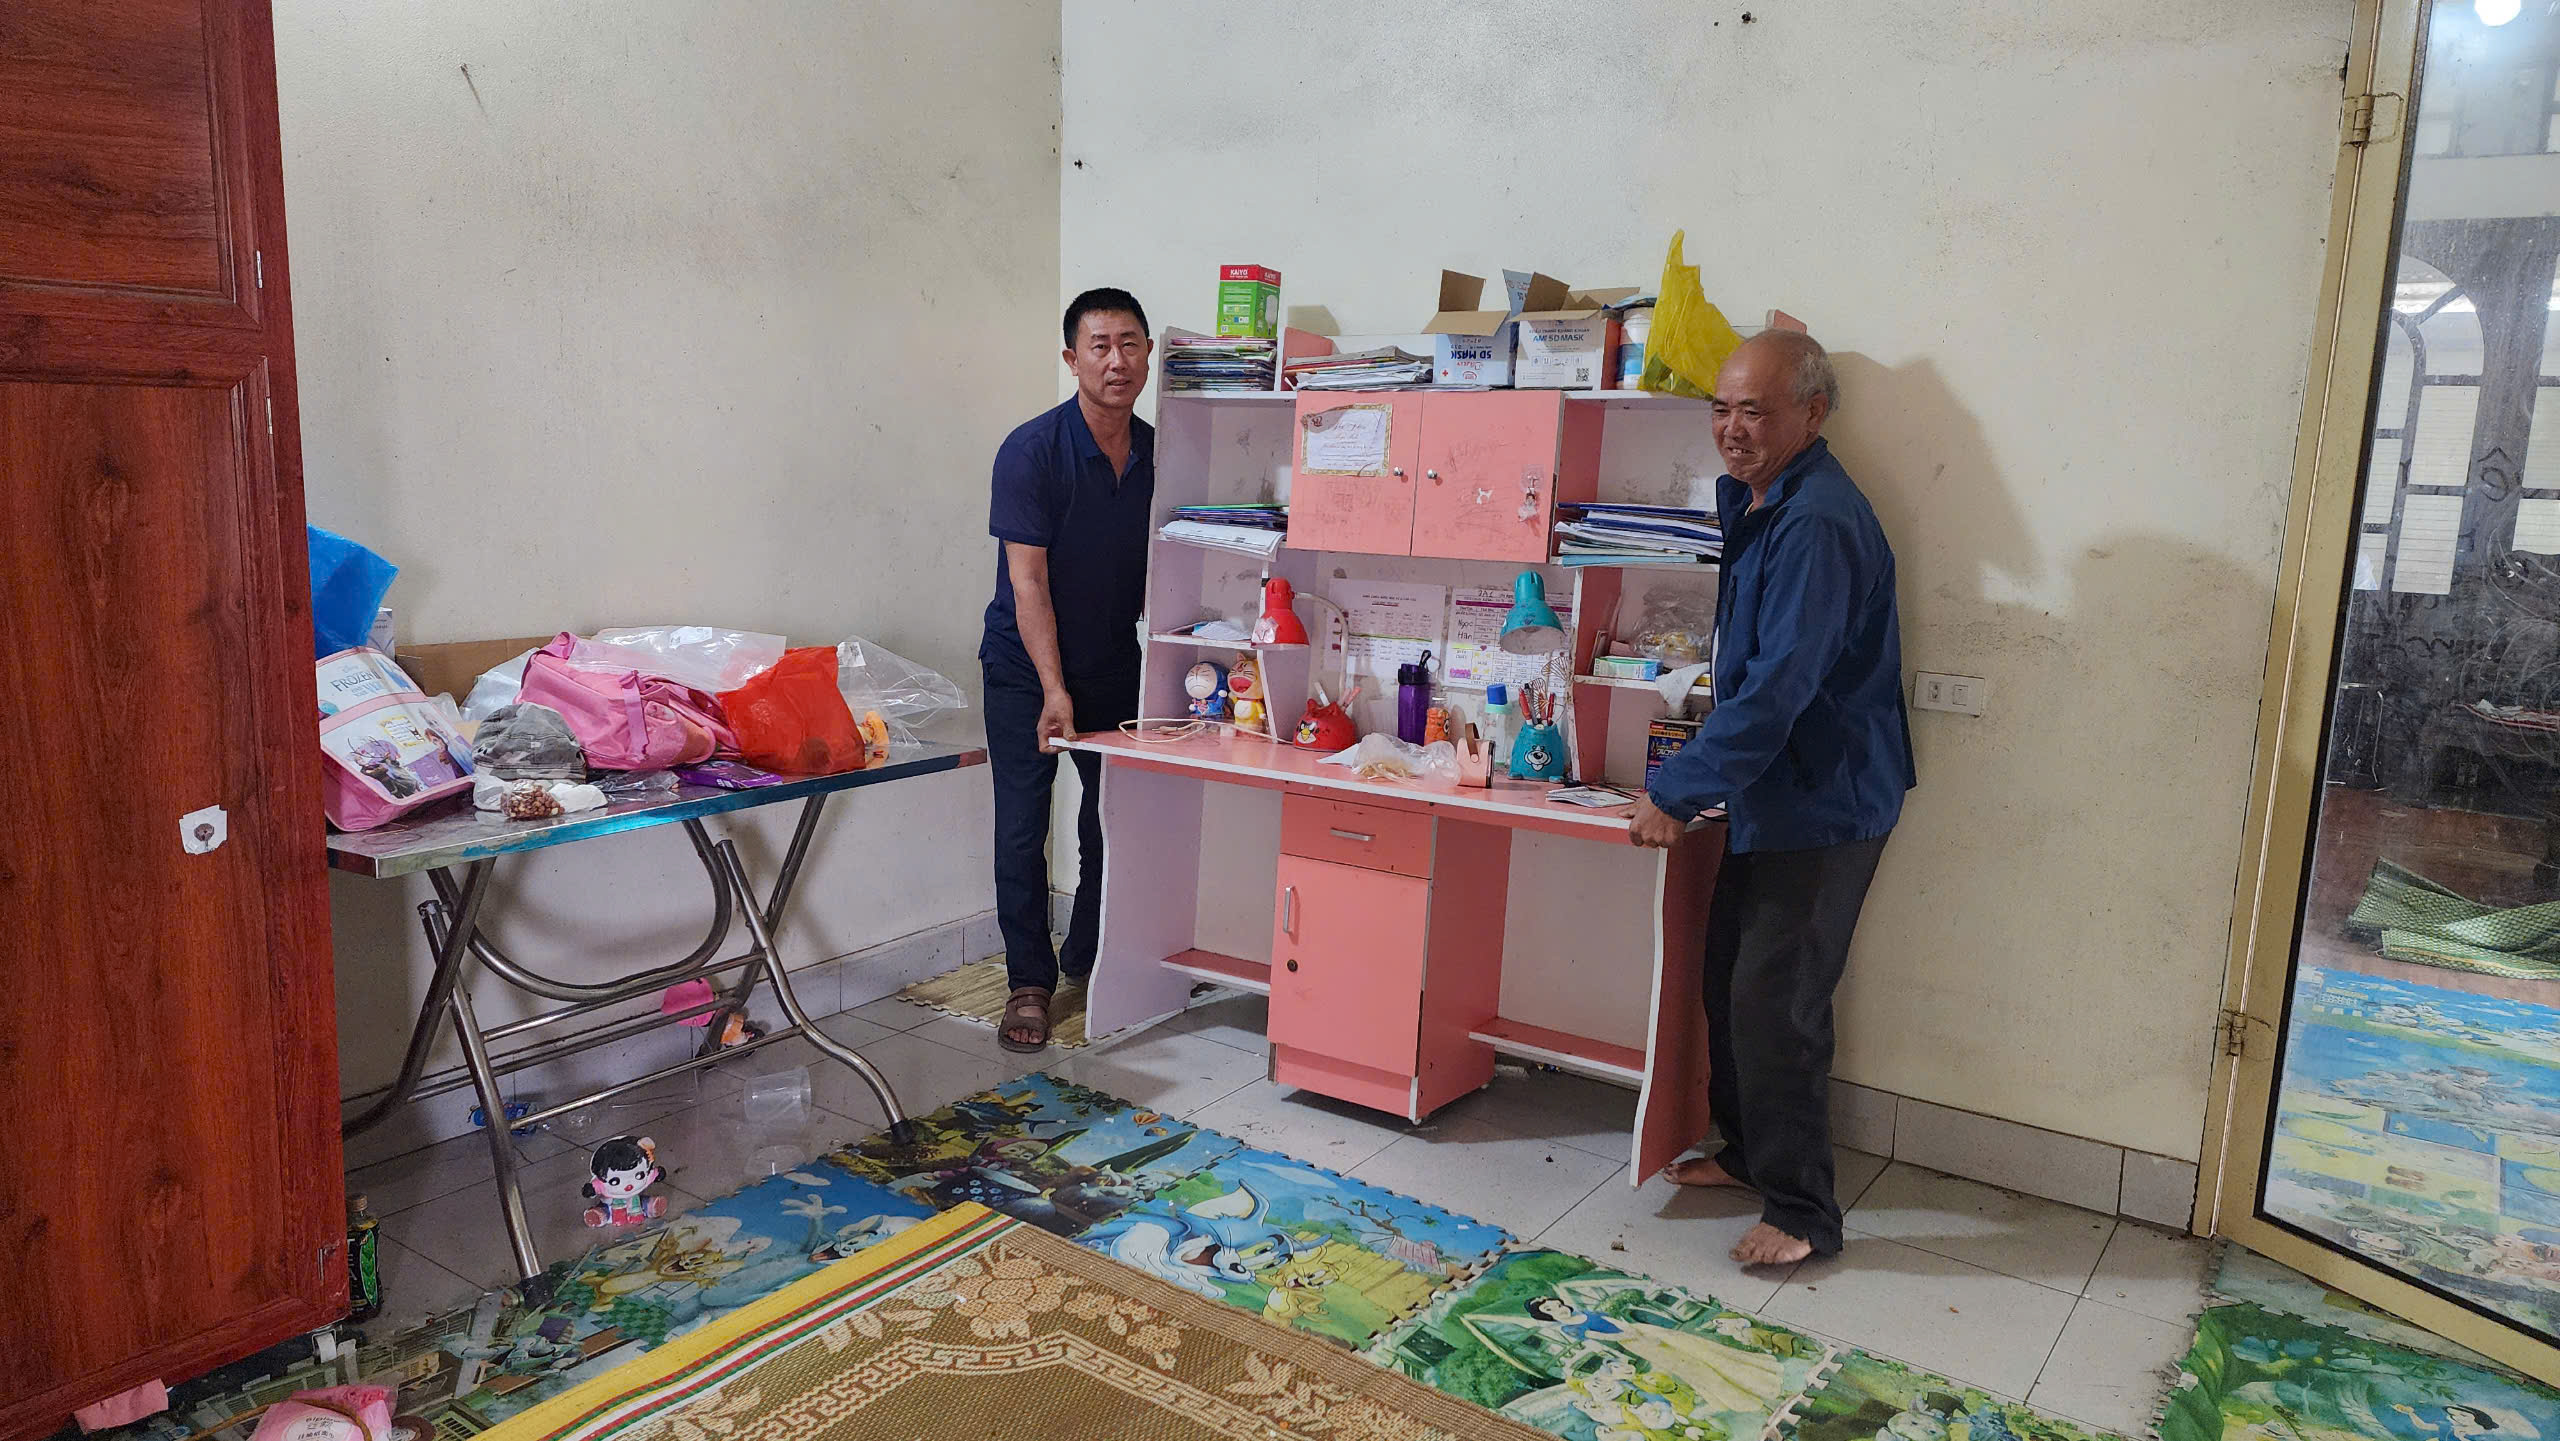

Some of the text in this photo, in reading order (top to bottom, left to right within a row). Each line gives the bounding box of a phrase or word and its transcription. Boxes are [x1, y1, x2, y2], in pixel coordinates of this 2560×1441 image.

[1561, 334, 1584, 342] MASK
[1450, 349, 1492, 359] 5D MASK
[330, 672, 374, 692] FROZEN
